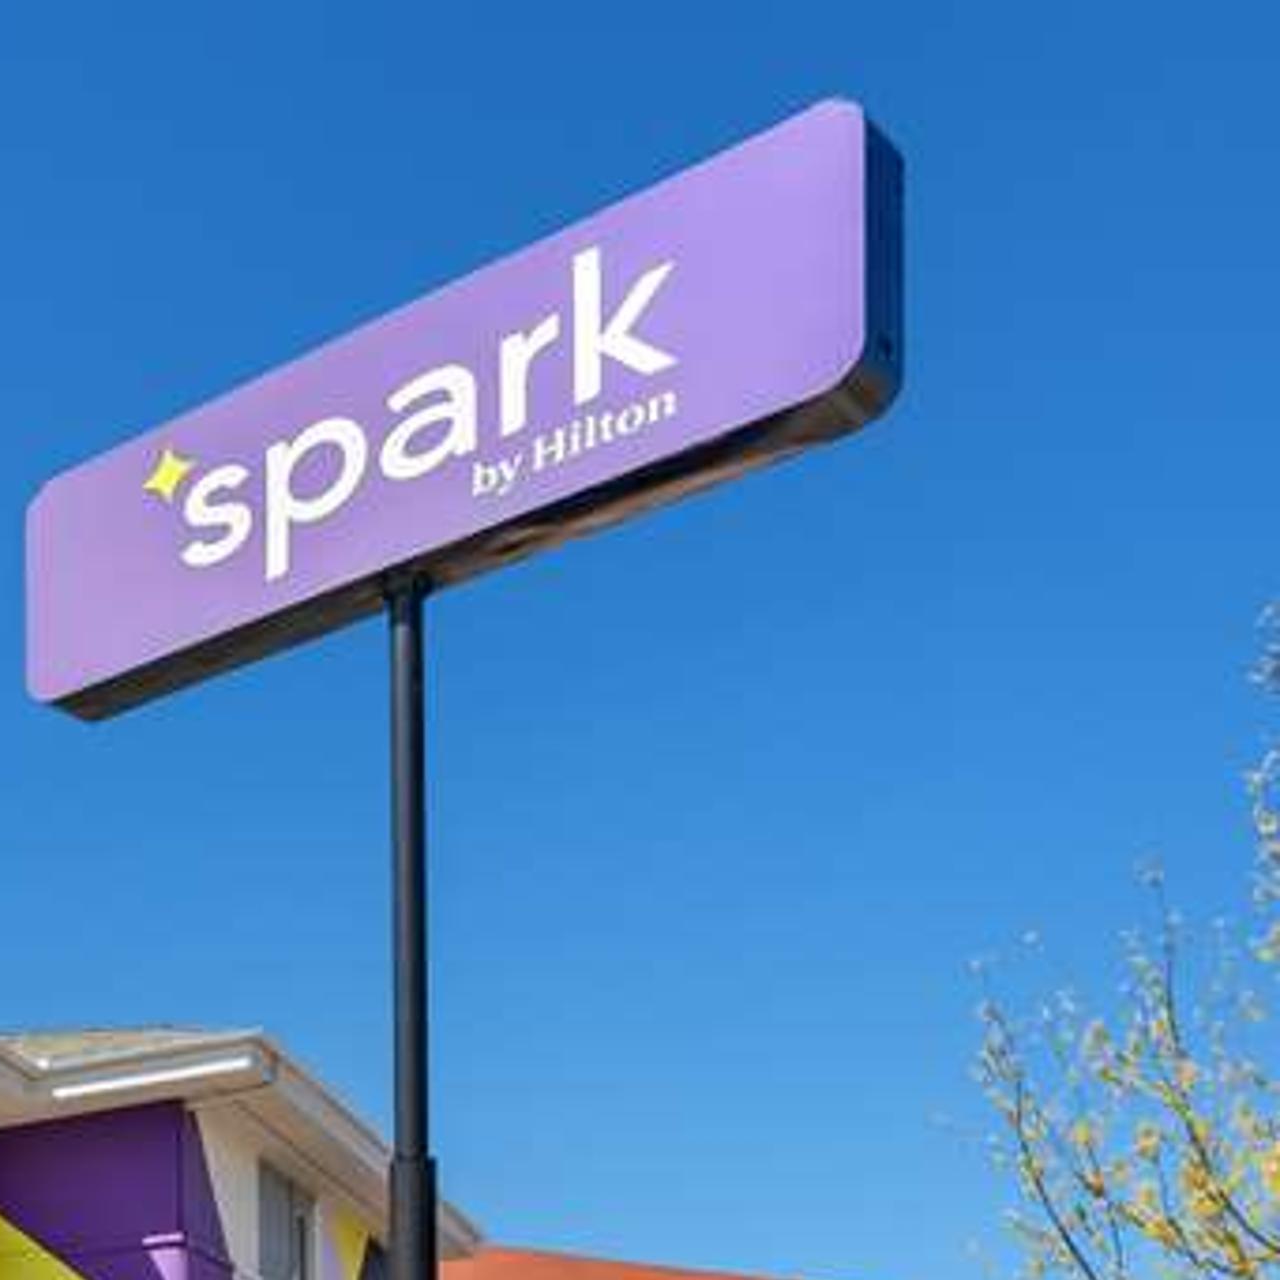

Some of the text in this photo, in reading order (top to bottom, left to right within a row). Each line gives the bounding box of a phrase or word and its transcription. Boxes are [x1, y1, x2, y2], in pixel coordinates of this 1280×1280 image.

[182, 246, 677, 581] spark
[472, 391, 676, 497] by Hilton
